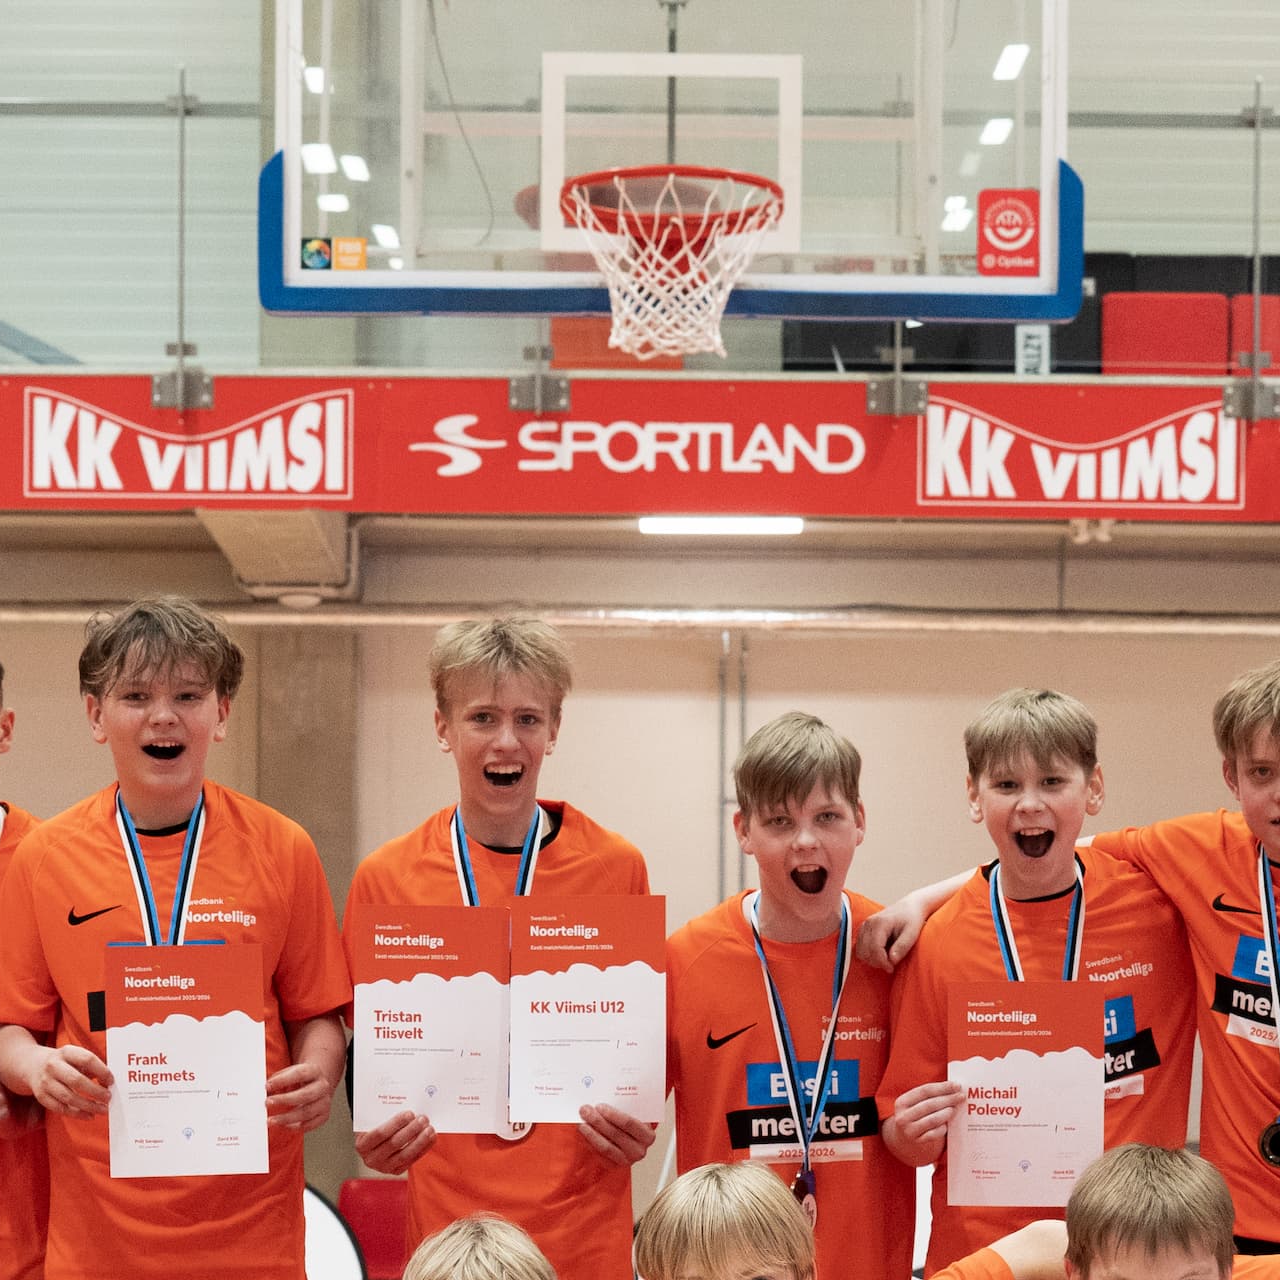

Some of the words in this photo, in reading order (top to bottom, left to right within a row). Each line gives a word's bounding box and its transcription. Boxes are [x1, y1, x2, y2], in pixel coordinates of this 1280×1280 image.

[33, 395, 123, 490] KK
[137, 400, 345, 493] VIIMSI
[518, 421, 866, 474] SPORTLAND
[925, 404, 1017, 498] KK
[1030, 410, 1238, 503] VIIMSI
[530, 925, 599, 940] Noorteliiga
[374, 934, 444, 949] Noorteliiga
[124, 975, 195, 990] Noorteliiga
[530, 1001, 551, 1014] KK
[554, 1000, 597, 1014] Viimsi
[600, 1001, 625, 1014] U12
[374, 1010, 422, 1024] Tristan
[967, 1010, 1037, 1025] Noorteliiga
[374, 1026, 424, 1040] Tiisvelt
[127, 1053, 168, 1066] Frank
[128, 1069, 196, 1086] Ringmets
[967, 1087, 1018, 1100] Michail
[967, 1103, 1022, 1118] Polevoy
[778, 1147, 835, 1158] 20252026
